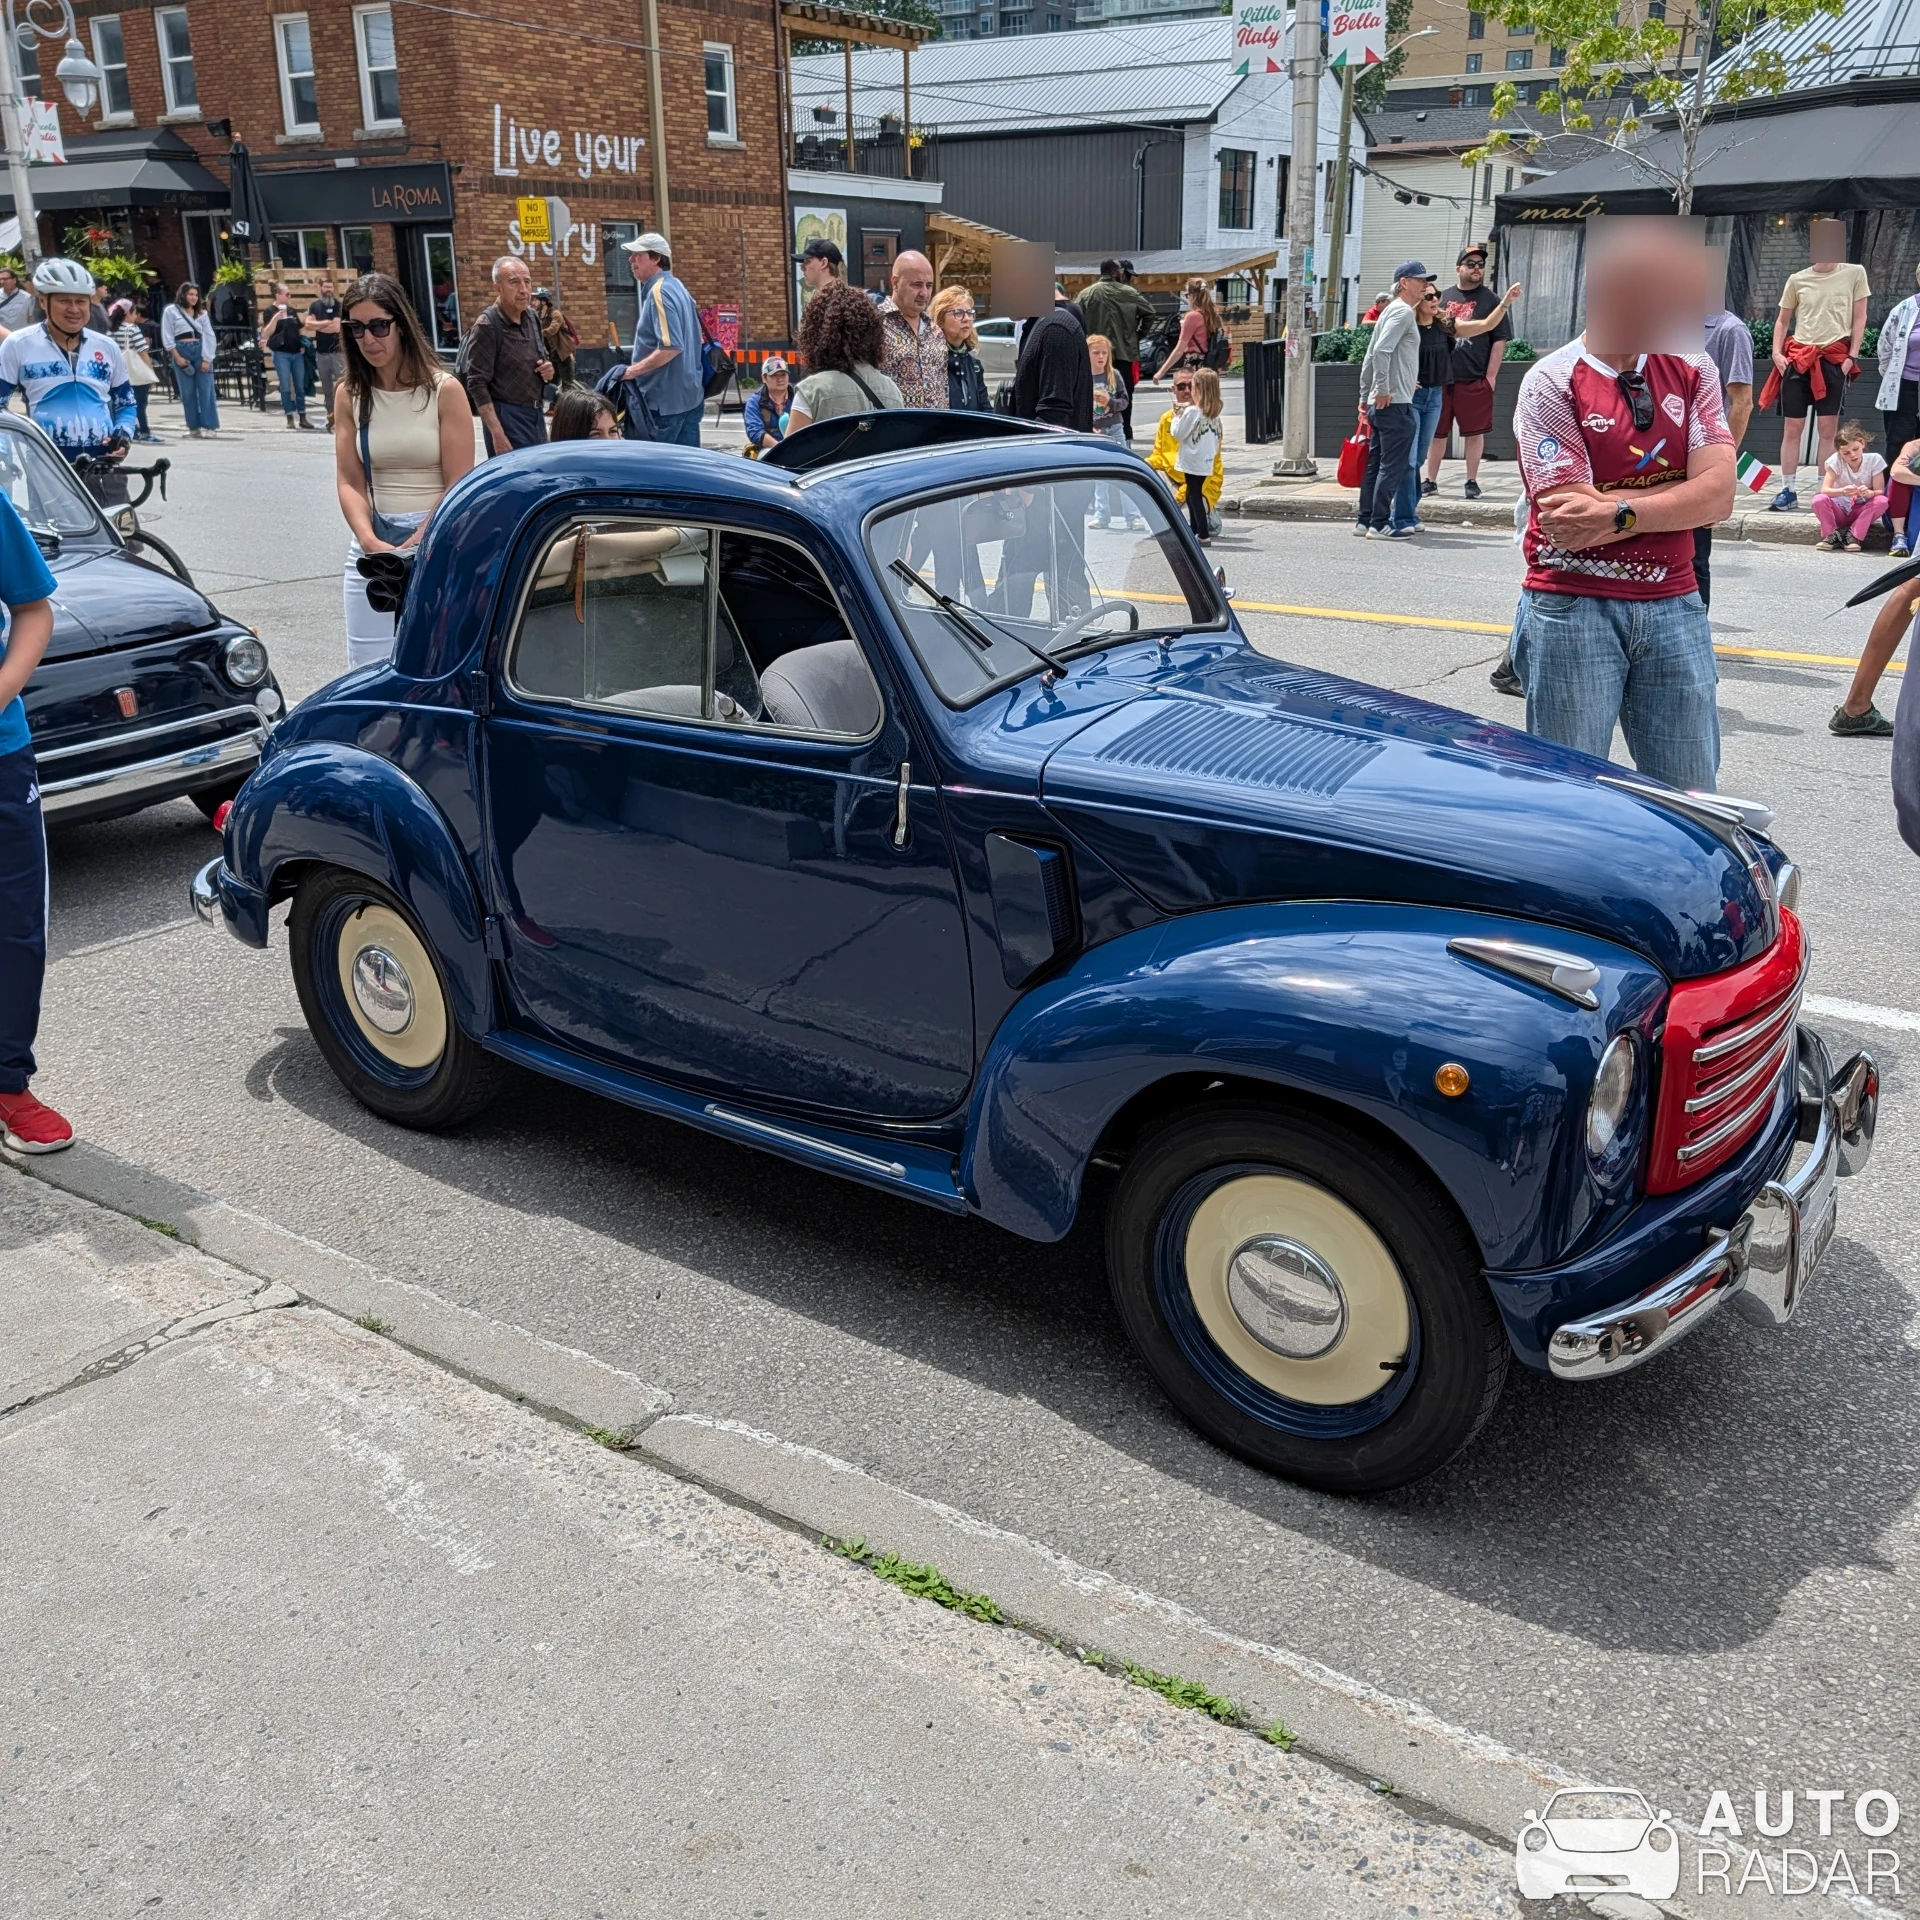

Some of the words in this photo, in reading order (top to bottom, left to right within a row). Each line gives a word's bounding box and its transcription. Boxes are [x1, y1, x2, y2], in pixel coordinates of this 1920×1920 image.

[1238, 4, 1282, 27] Little
[1332, 12, 1382, 36] Bella
[1236, 25, 1282, 50] Italy
[493, 103, 562, 176] Live
[574, 131, 645, 179] your
[371, 186, 392, 208] LA
[393, 184, 442, 215] ROMA
[526, 203, 538, 212] NO
[1515, 195, 1605, 219] mati
[524, 216, 542, 225] EXIT
[506, 219, 596, 265] sry
[521, 228, 548, 238] IMPASSE
